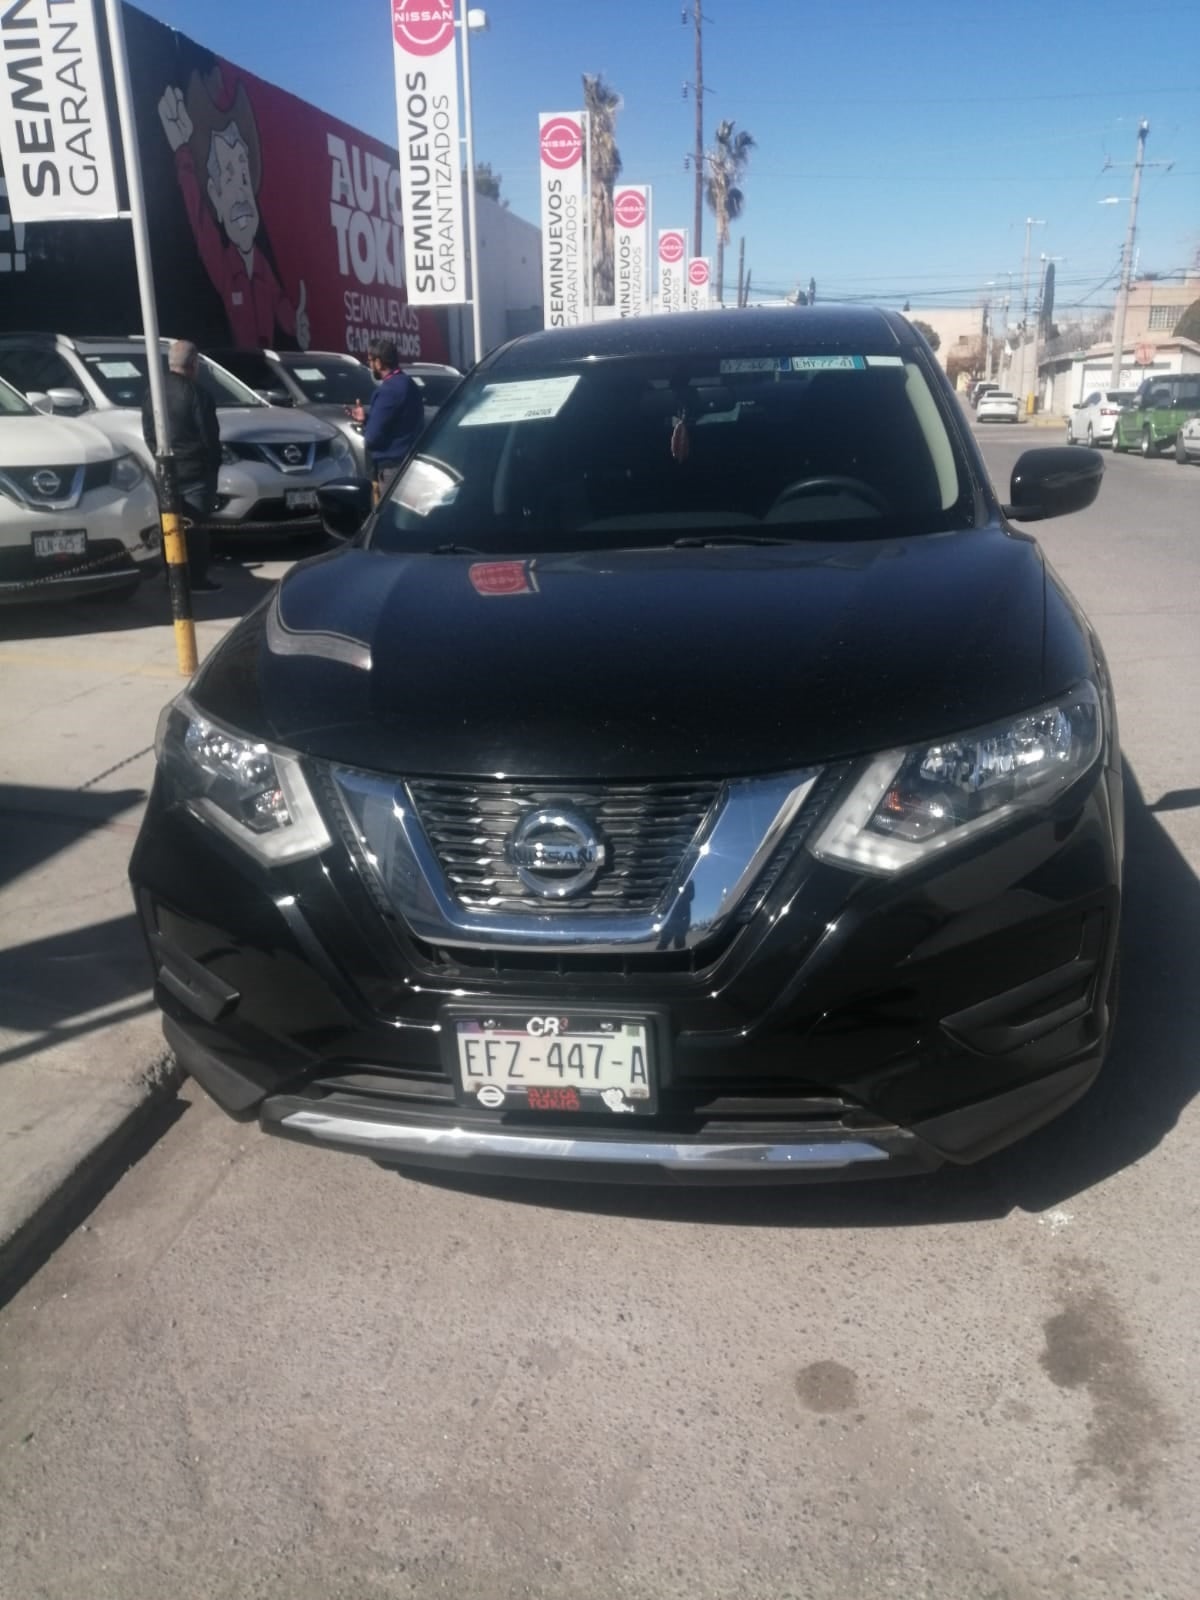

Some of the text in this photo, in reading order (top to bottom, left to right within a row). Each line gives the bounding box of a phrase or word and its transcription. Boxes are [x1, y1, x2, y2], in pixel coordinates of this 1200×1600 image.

[394, 10, 453, 22] NISSAN
[406, 71, 436, 293] SEMINUEVOS
[541, 139, 582, 148] NISSAN
[432, 94, 457, 293] GARANTIZADOS
[548, 178, 565, 328] SEMINUEVOS
[465, 1040, 647, 1084] EFZ-447-A
